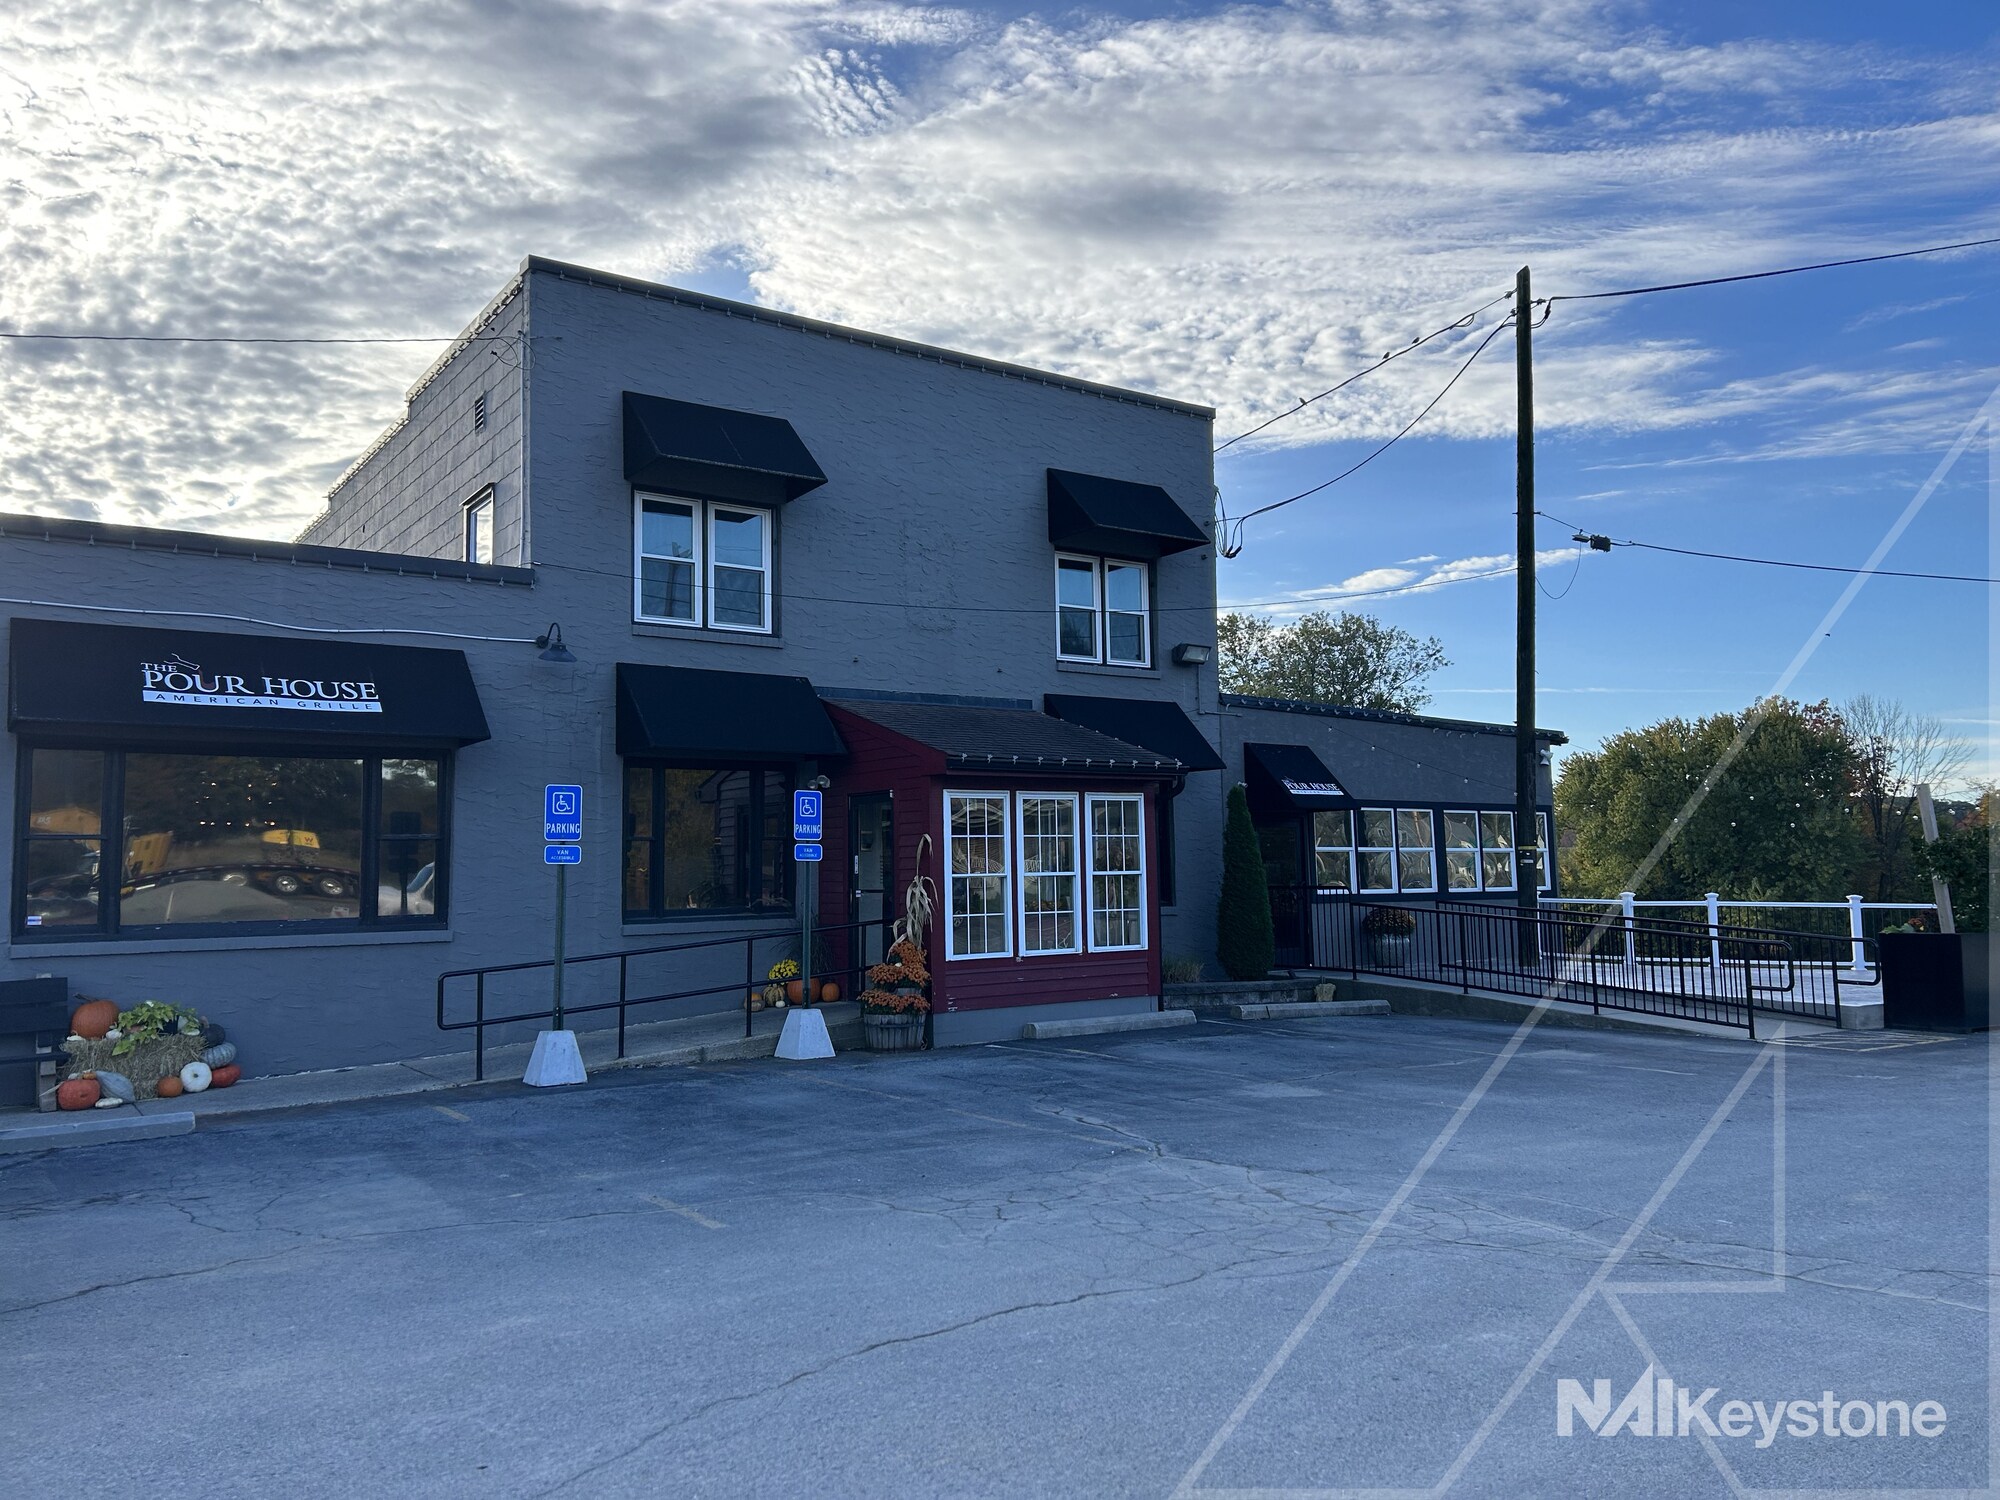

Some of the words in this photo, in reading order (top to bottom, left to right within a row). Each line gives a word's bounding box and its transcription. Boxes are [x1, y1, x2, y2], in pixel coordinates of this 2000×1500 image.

[141, 662, 178, 673] THE
[141, 669, 254, 694] POUR
[261, 676, 379, 700] HOUSE
[156, 693, 279, 706] AMERICAN
[297, 700, 373, 710] GRILLE
[546, 823, 580, 834] PARKING
[795, 824, 821, 834] PARKING
